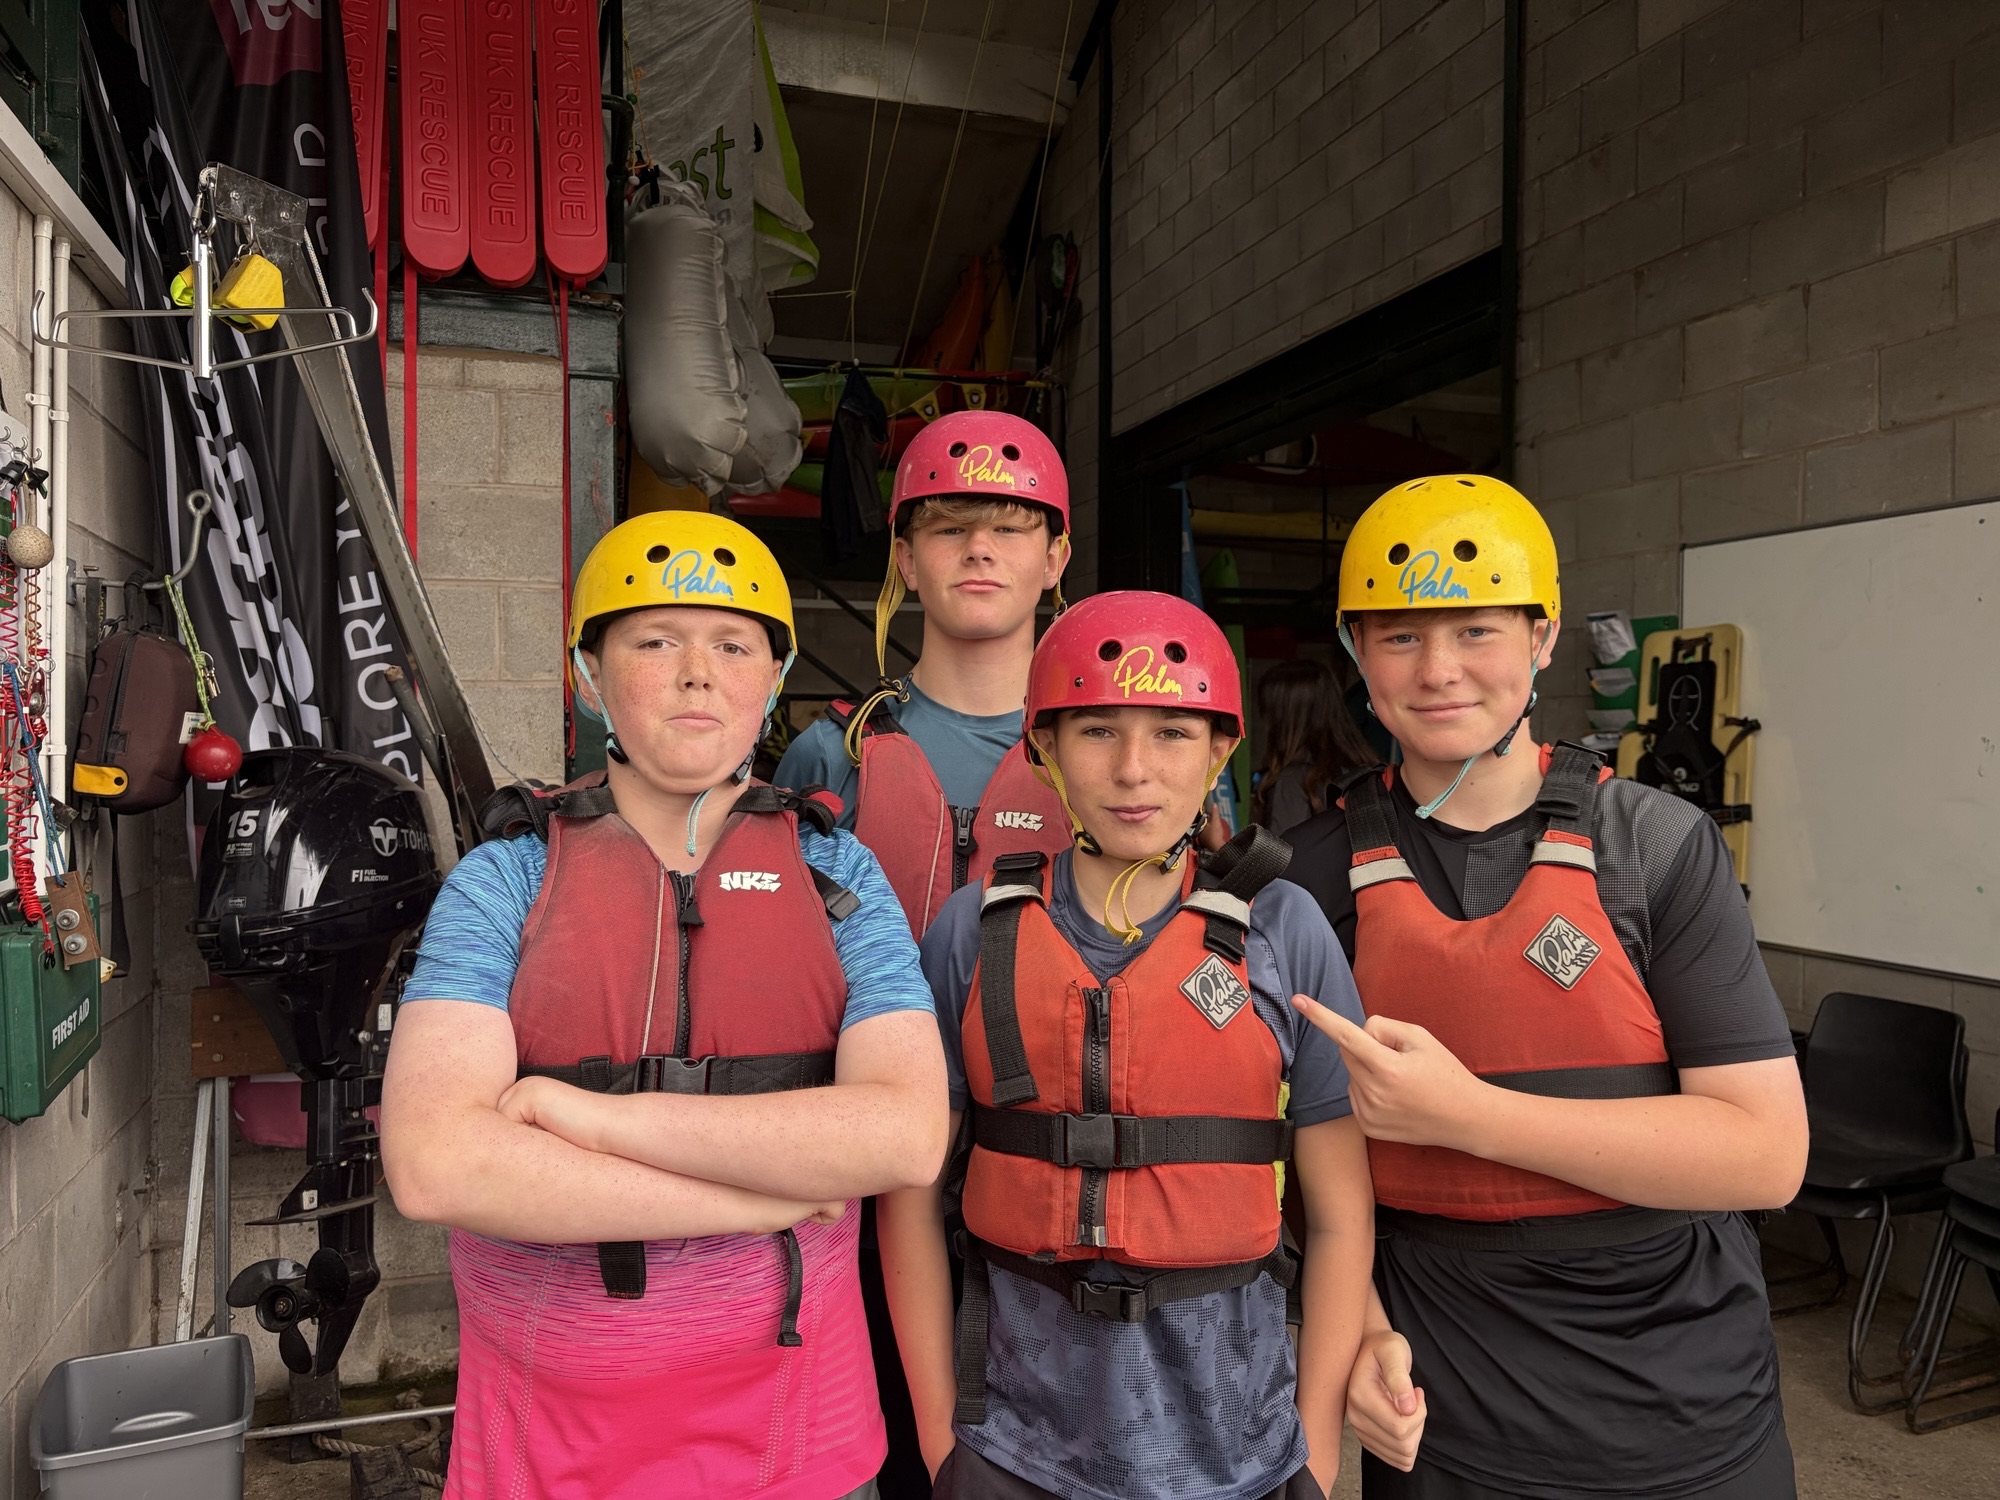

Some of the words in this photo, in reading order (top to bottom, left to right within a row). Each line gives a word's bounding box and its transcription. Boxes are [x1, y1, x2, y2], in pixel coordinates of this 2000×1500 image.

[418, 13, 447, 63] UK
[486, 32, 513, 79] UK
[553, 28, 580, 72] UK
[420, 71, 449, 215] RESCUE
[487, 88, 516, 227] RESCUE
[556, 84, 587, 220] RESCUE
[959, 445, 1015, 487] Palm
[662, 550, 733, 599] Palm
[1398, 550, 1469, 605] Palm
[1113, 645, 1183, 698] Palm
[227, 809, 260, 839] 15
[351, 869, 363, 882] FI
[1539, 934, 1589, 975] Palm
[1195, 972, 1241, 1014] Palm
[52, 1010, 77, 1050] FIRST
[78, 997, 90, 1026] AID
